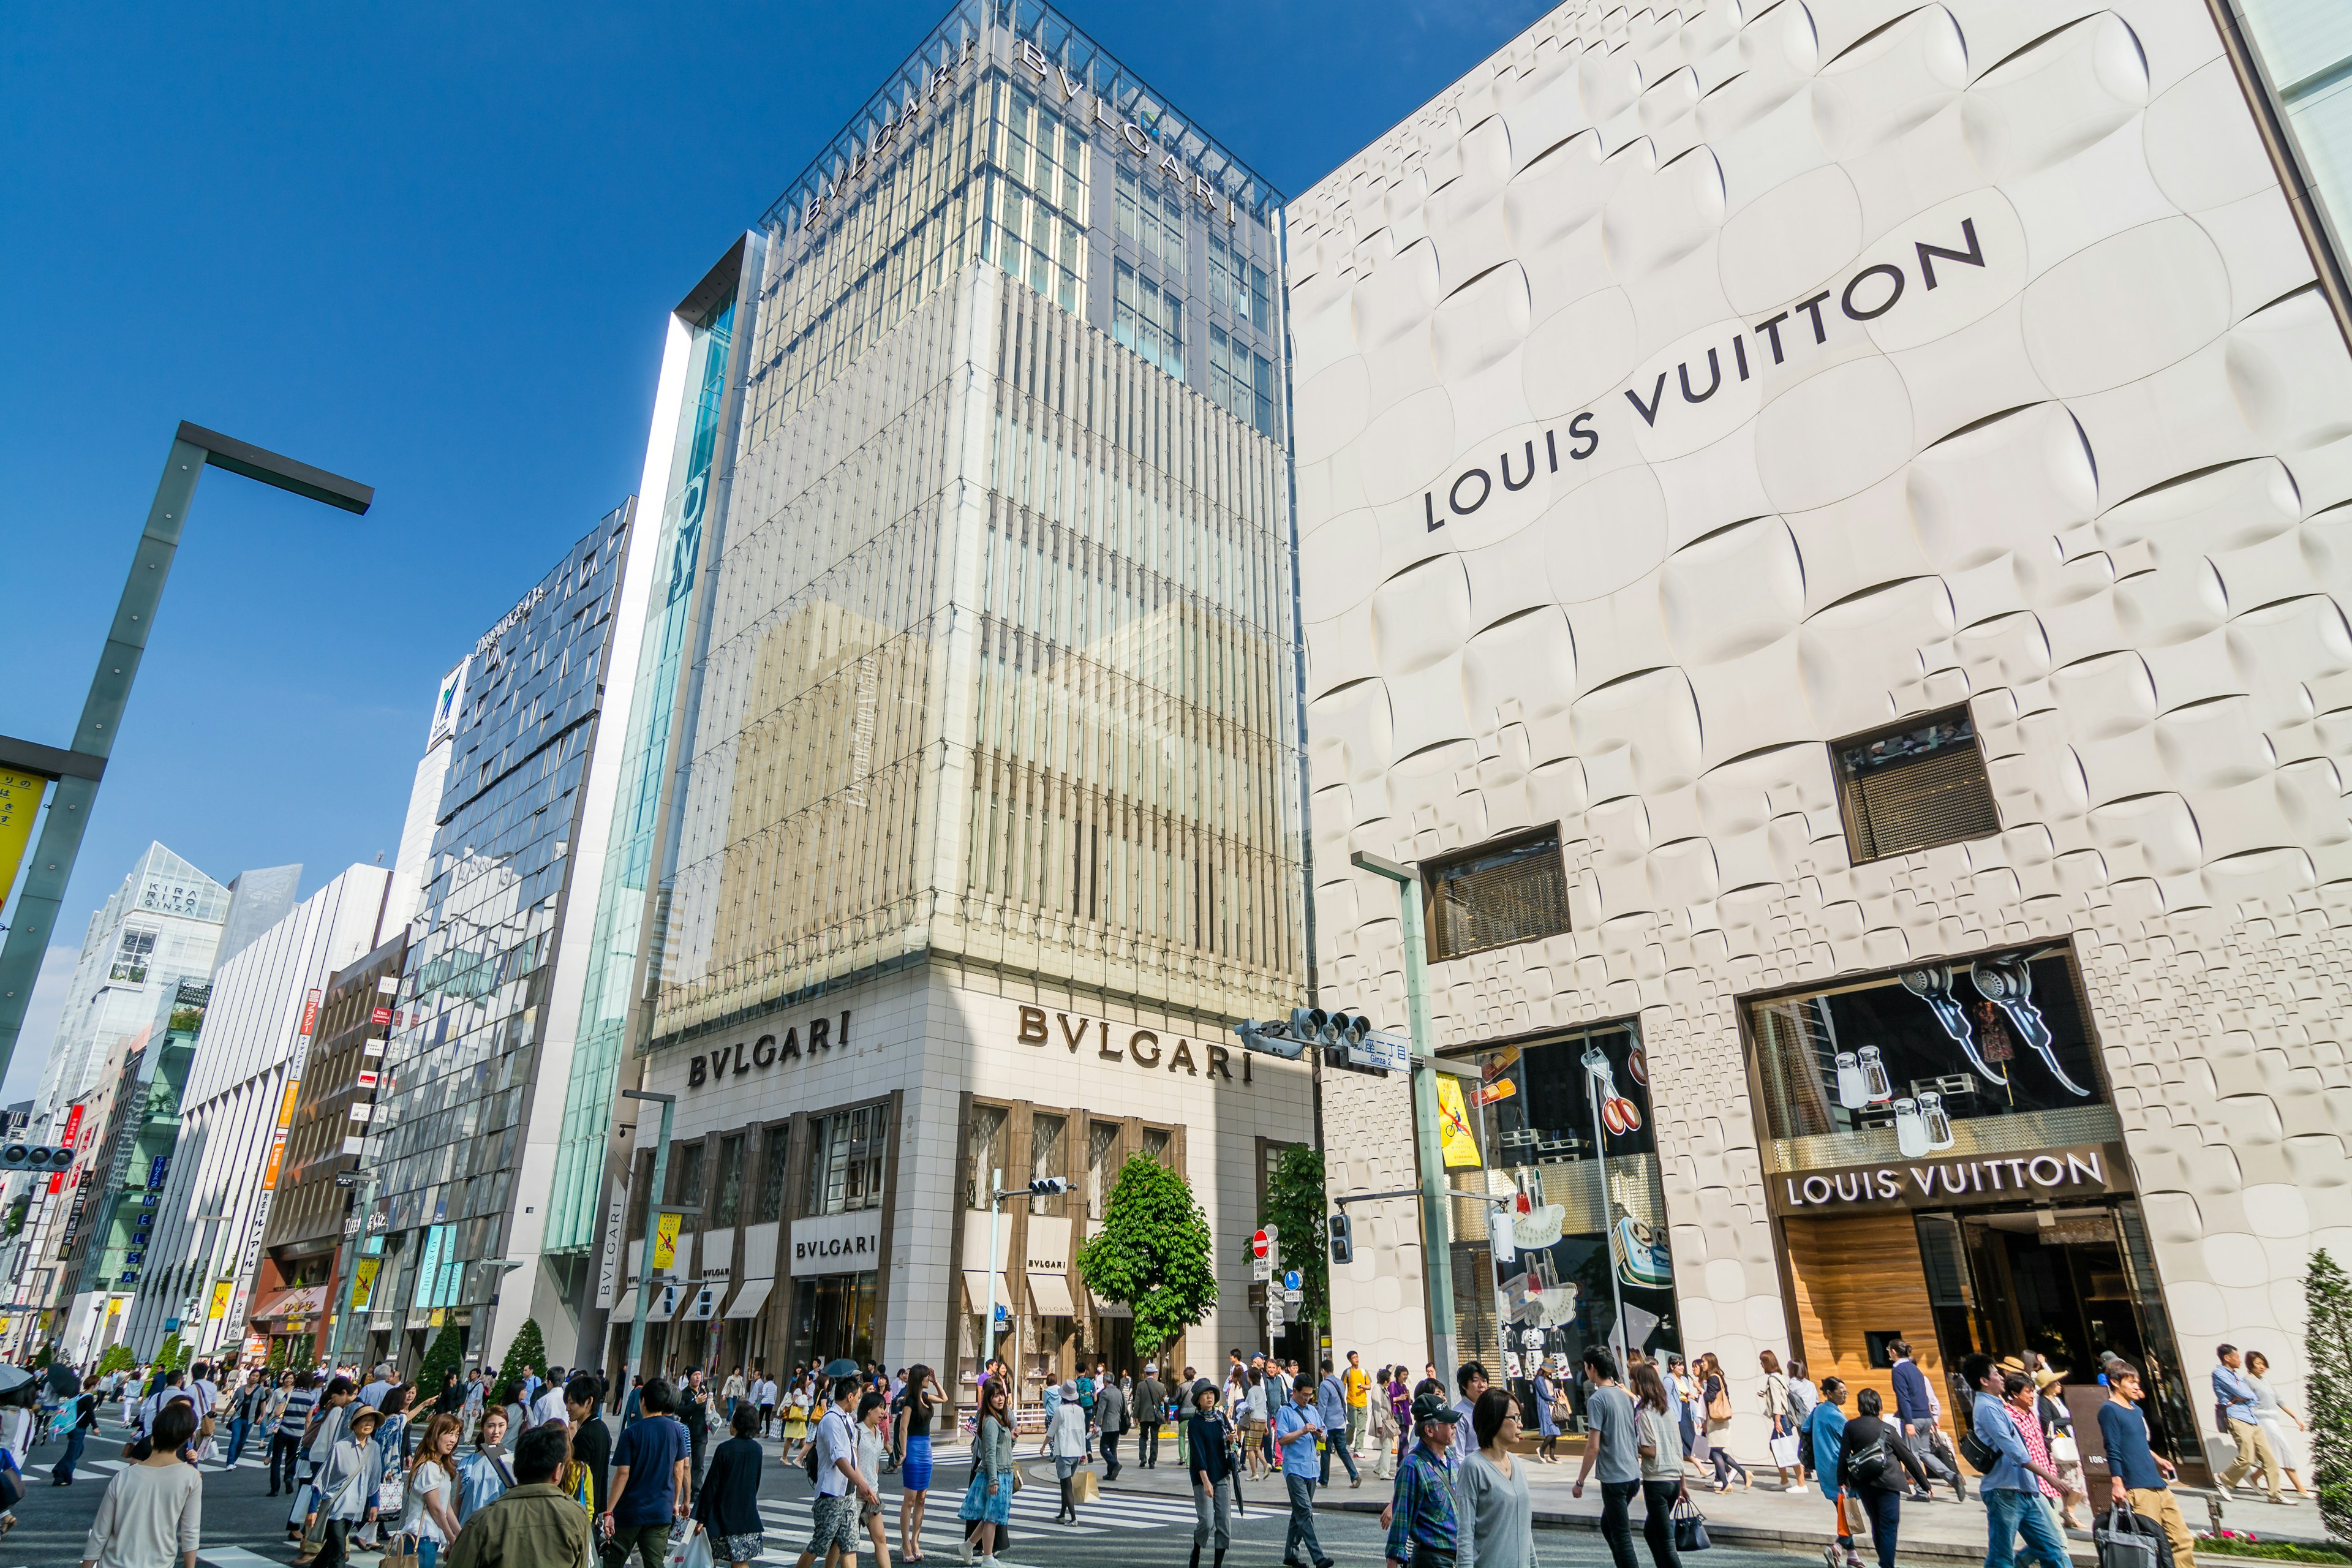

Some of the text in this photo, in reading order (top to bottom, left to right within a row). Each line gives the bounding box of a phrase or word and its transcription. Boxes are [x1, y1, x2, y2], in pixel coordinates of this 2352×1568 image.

[804, 39, 971, 230] BVLGARI
[1021, 38, 1236, 227] BVLGARI
[1424, 217, 1985, 533] LOUIS VUITTON
[145, 900, 193, 914] GINZA
[147, 891, 195, 905] RITO
[687, 1009, 851, 1087] BVLGARI
[1017, 1005, 1252, 1082] BVLGARI
[1354, 1038, 1406, 1060] 座二丁目
[1370, 1054, 1386, 1065] Ginza
[1787, 1152, 2105, 1205] LOUIS VUITTON
[124, 1197, 155, 1283] MELSA
[601, 1204, 621, 1295] BVLGARI
[796, 1235, 875, 1259] BVLGARI
[1029, 1259, 1066, 1269] BVLGARI
